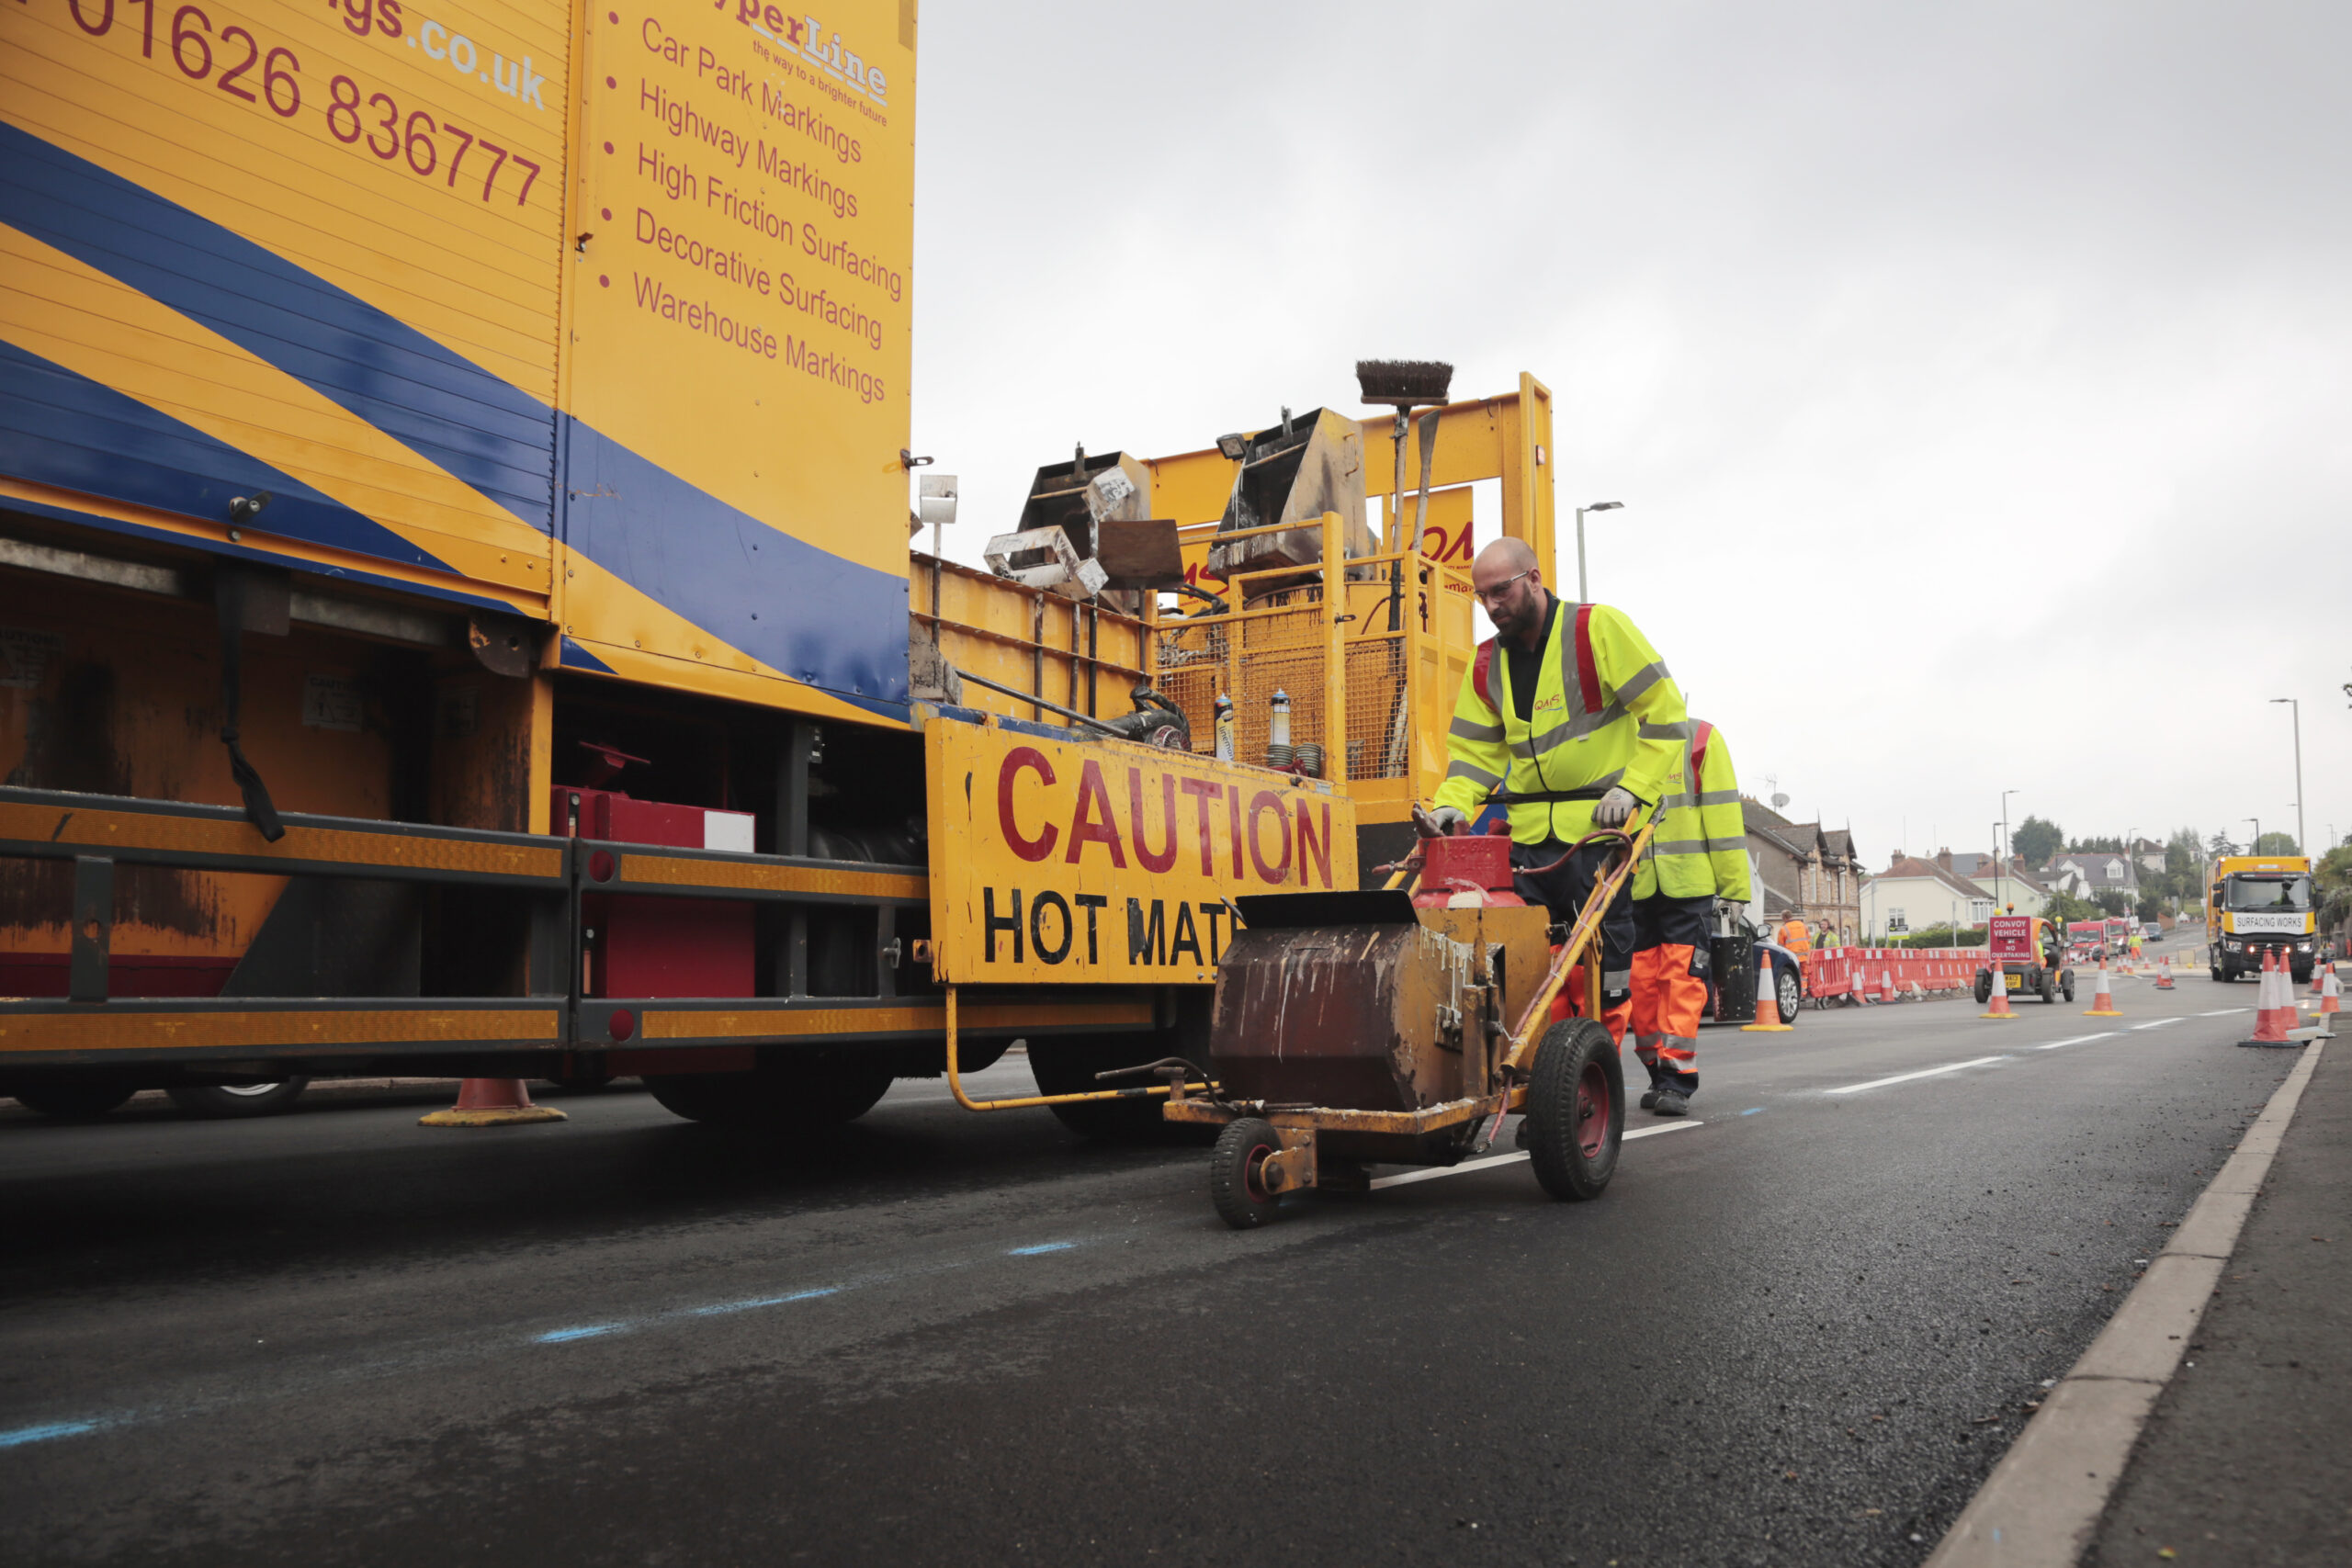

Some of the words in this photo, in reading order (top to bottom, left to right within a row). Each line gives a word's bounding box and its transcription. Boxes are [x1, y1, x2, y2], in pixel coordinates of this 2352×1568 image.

[328, 0, 546, 111] gs.co.uk
[642, 17, 690, 68] Car
[698, 46, 753, 106] Park
[762, 81, 862, 164] Markings
[714, 0, 888, 96] perLine
[752, 39, 770, 61] the
[773, 53, 793, 75] way
[797, 65, 807, 81] to
[809, 75, 816, 85] a
[818, 76, 857, 109] brighter
[859, 101, 888, 127] future
[326, 74, 541, 207] 836777
[640, 77, 749, 168] Highway
[758, 139, 858, 219] Markings
[636, 207, 771, 296] Decorative
[779, 273, 882, 351] Surfacing
[639, 141, 696, 200] High
[707, 175, 793, 245] Friction
[802, 223, 901, 302] Surfacing
[634, 271, 777, 359] Warehouse
[786, 333, 885, 404] Markings
[997, 746, 1333, 890] CAUTION
[982, 886, 1108, 966] HOT
[1994, 929, 2027, 937] VEHICLE
[2236, 917, 2275, 927] SURFACING
[2277, 917, 2302, 928] WORKS
